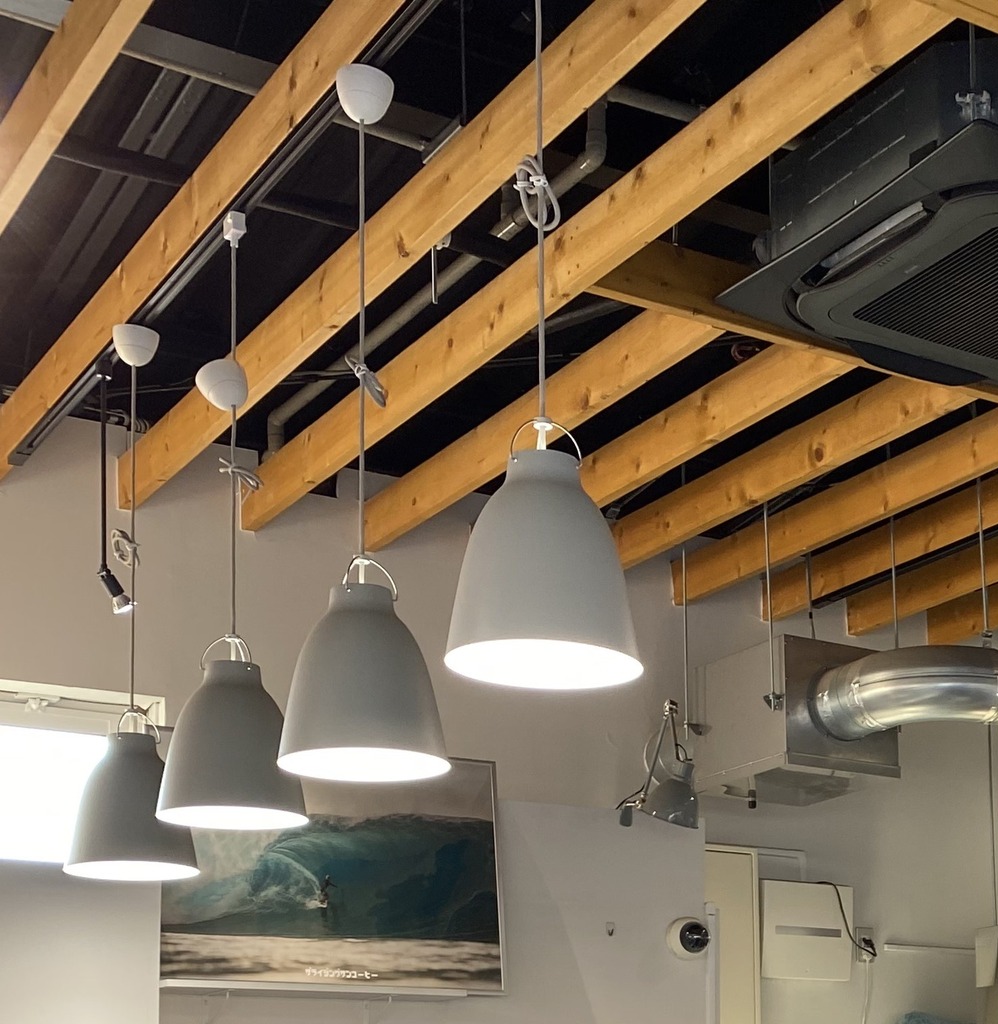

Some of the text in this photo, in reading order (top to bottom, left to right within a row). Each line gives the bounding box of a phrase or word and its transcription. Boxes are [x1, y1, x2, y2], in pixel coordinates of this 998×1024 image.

[304, 966, 379, 980] ザライジングサンコーヒー
